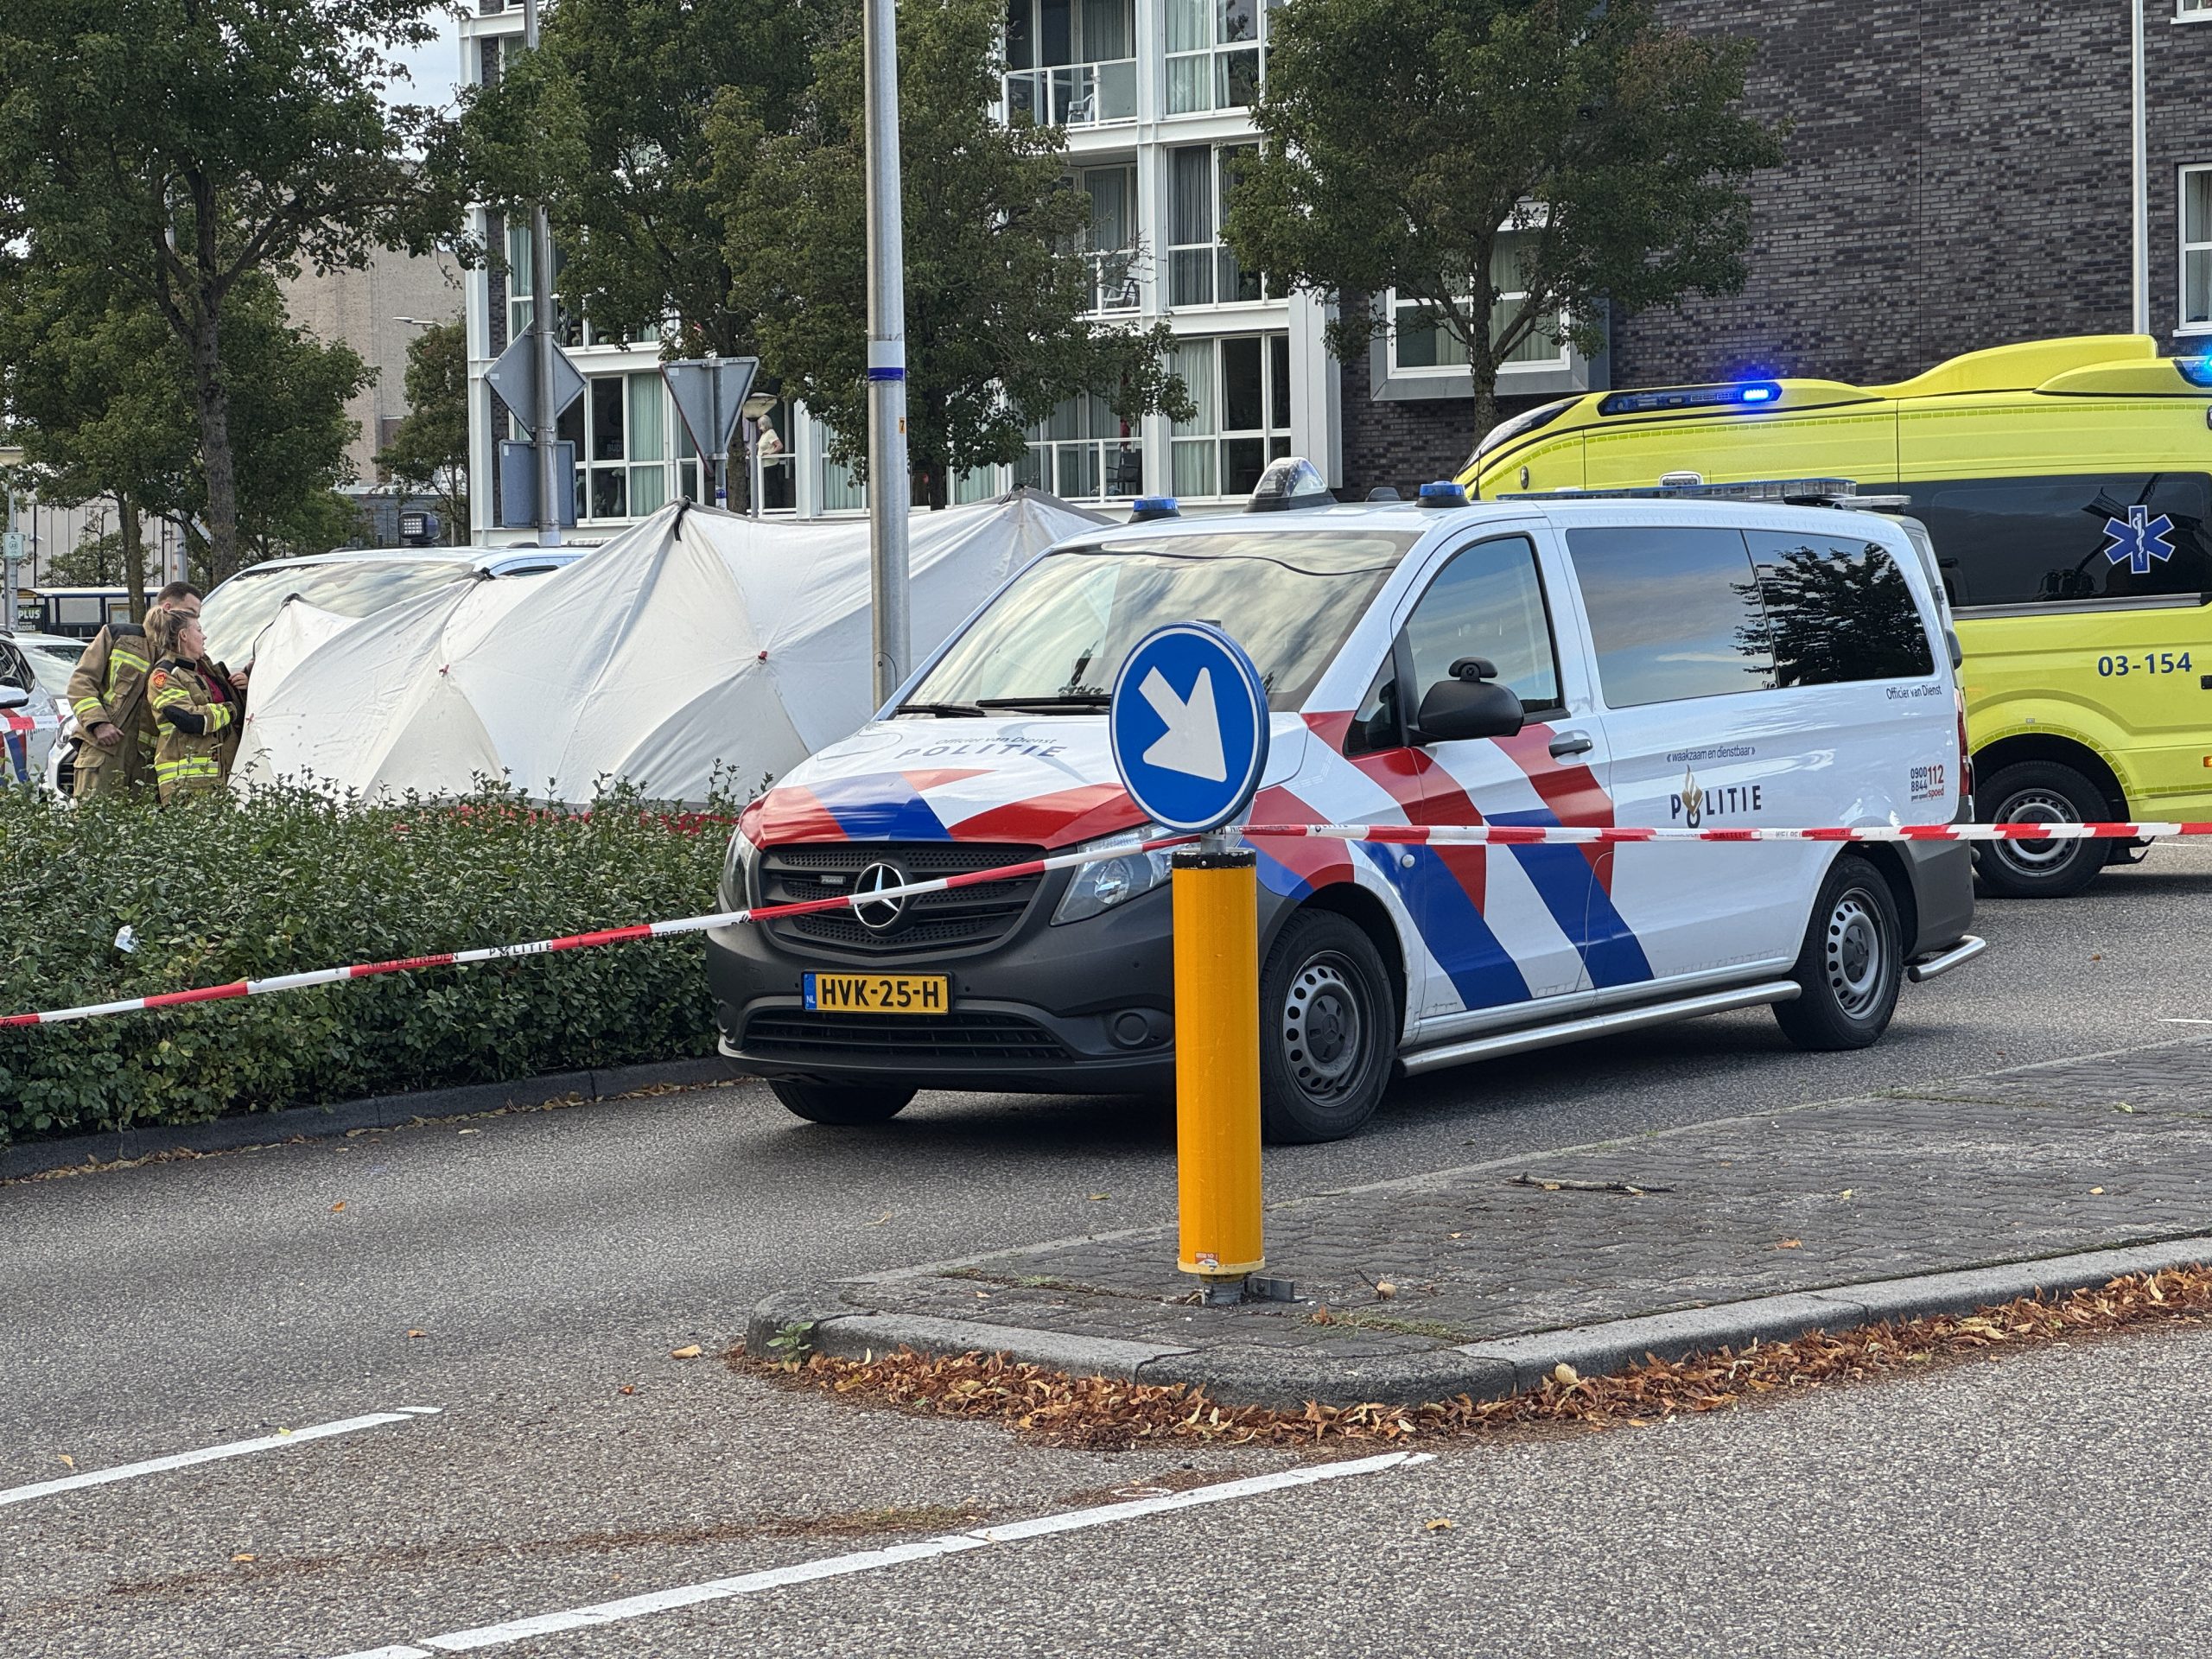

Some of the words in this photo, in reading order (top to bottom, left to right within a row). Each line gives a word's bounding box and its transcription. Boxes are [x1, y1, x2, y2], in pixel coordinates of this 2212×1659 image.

[18, 609, 41, 620] PLUS
[2098, 652, 2192, 677] 03-154
[1885, 686, 1909, 700] Officier
[1910, 688, 1922, 697] van
[1922, 684, 1942, 696] Dienst
[1012, 736, 1058, 745] Dienst
[894, 744, 1067, 759] POLITIE
[1910, 766, 1927, 779] 0900
[1928, 765, 1944, 785] 112
[1911, 779, 1928, 791] 8844
[1671, 785, 1762, 829] POLITIE
[821, 978, 939, 1008] HVK-25-H
